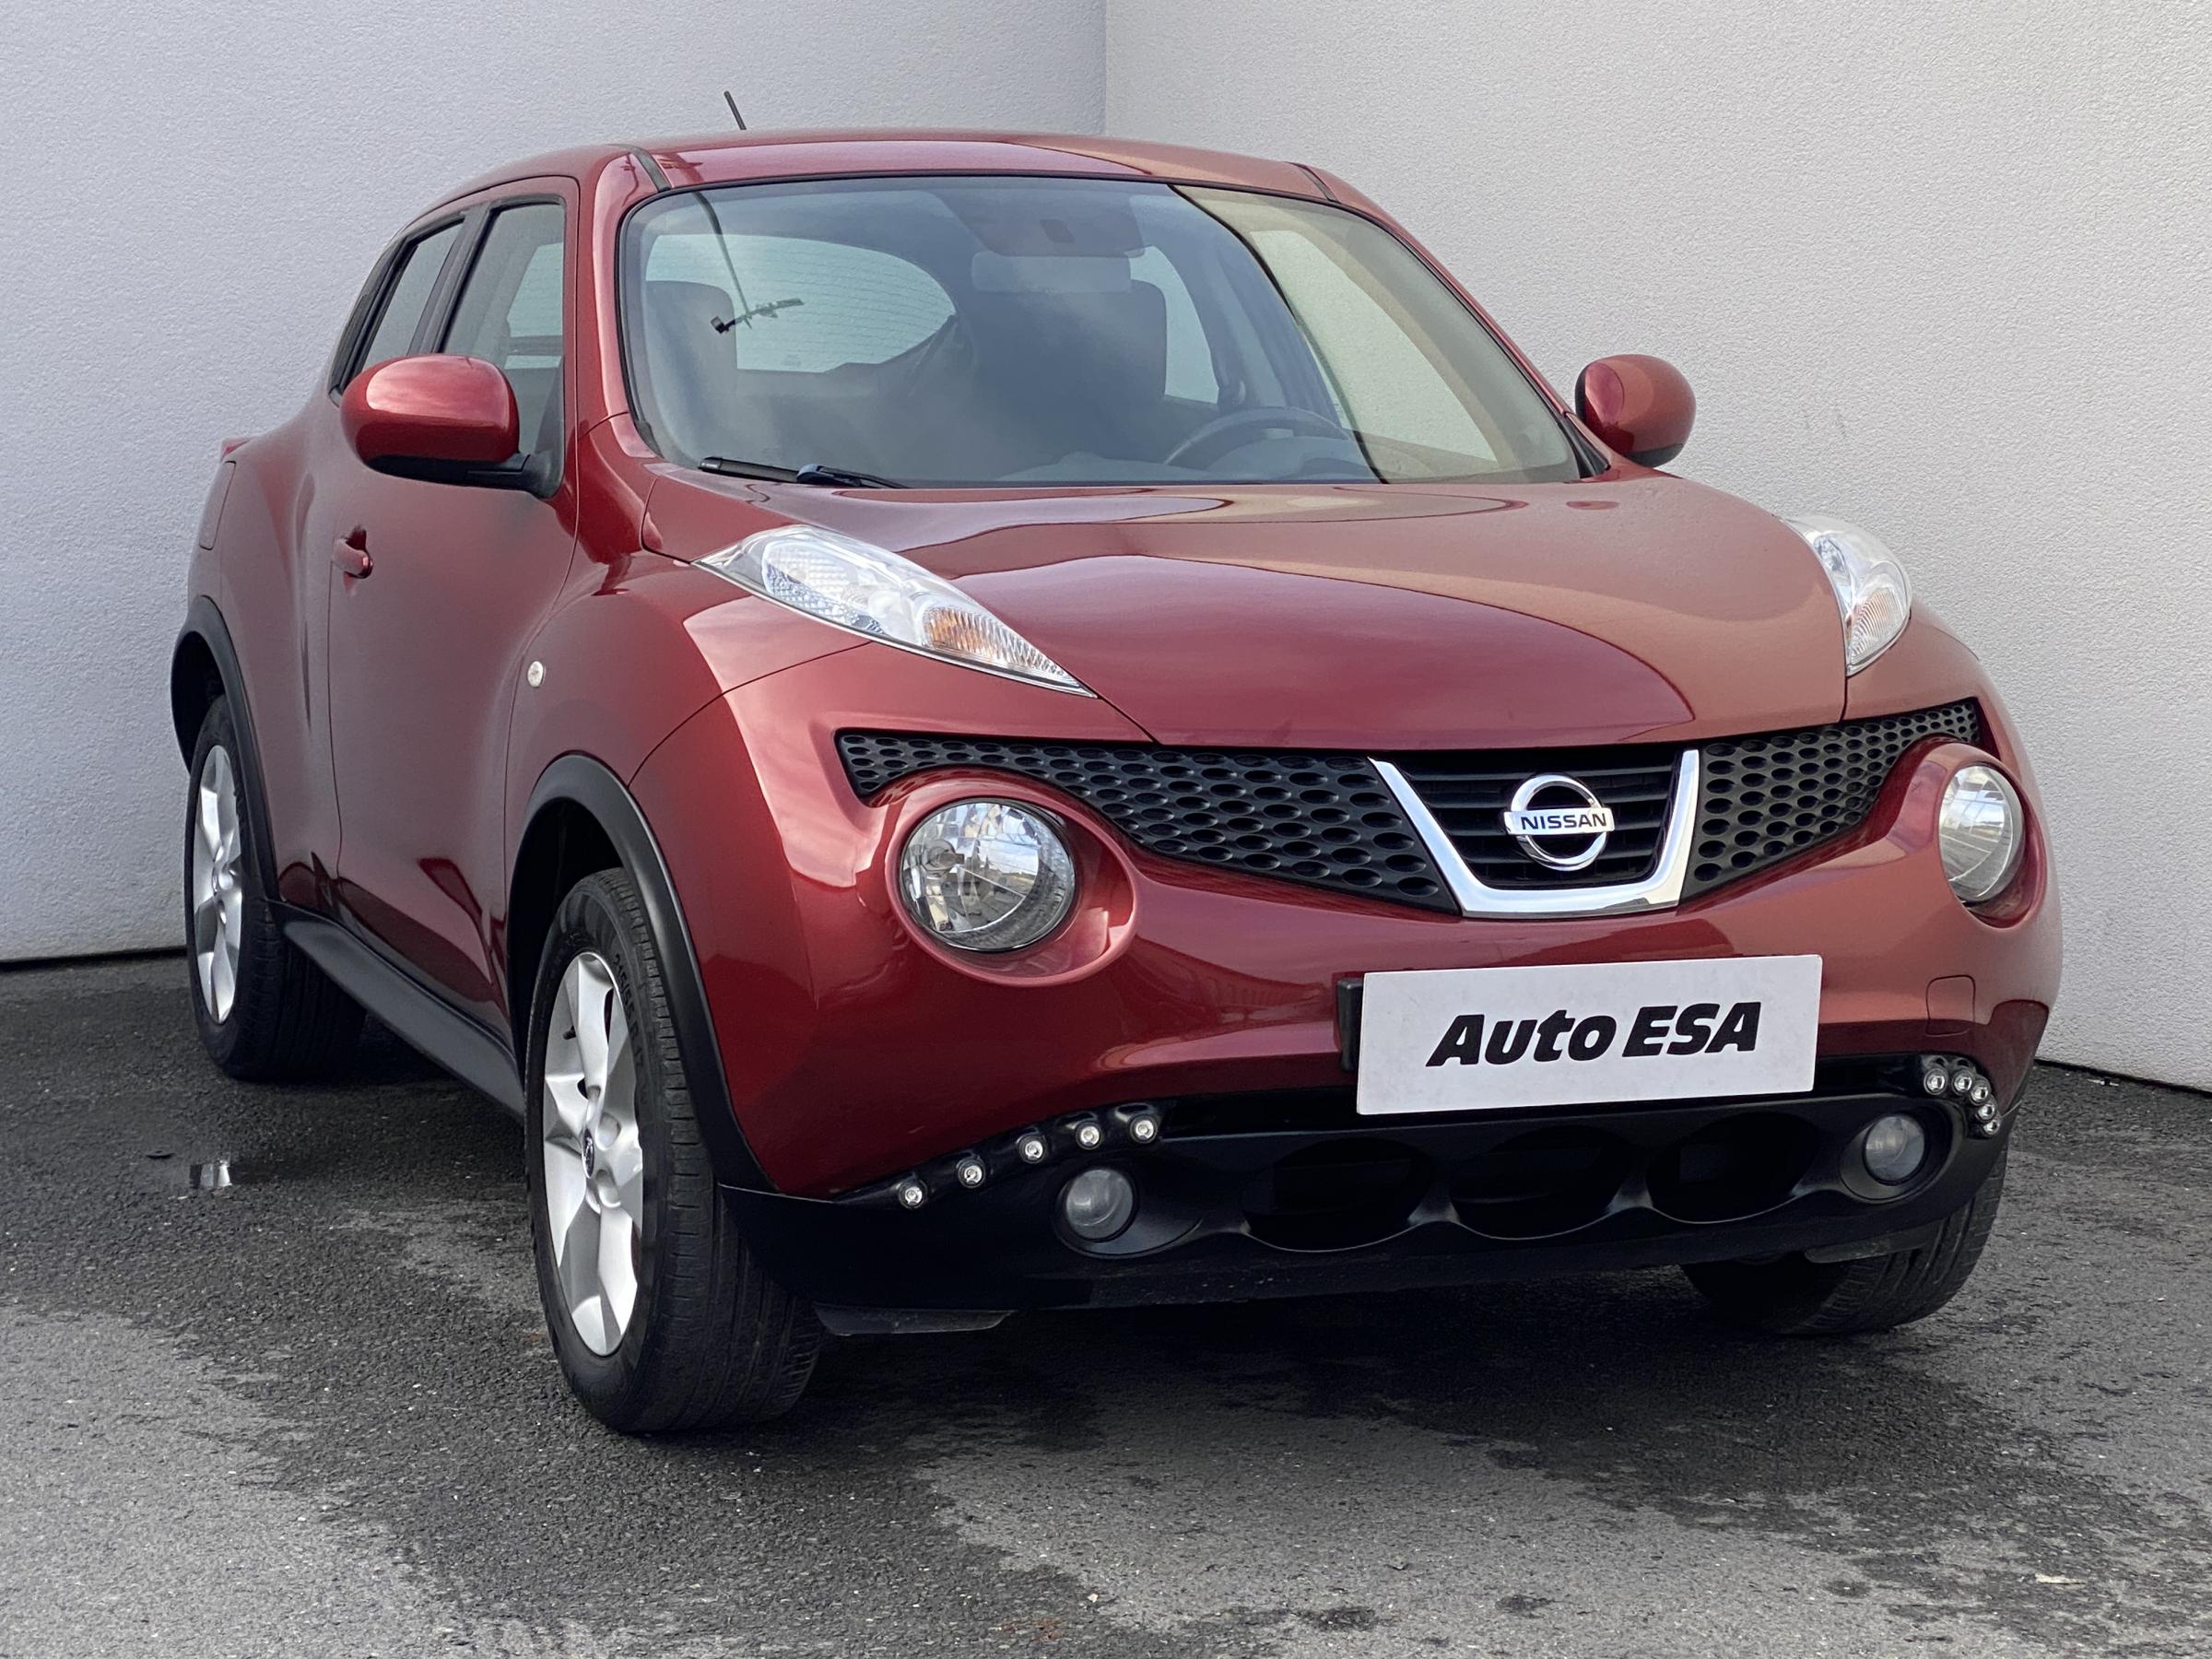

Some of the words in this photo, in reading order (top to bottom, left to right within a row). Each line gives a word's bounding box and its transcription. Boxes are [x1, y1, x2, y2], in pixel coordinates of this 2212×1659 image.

[1521, 813, 1606, 830] NISSAN
[1426, 1009, 1617, 1067] Auto
[1622, 1001, 1761, 1058] ESA
